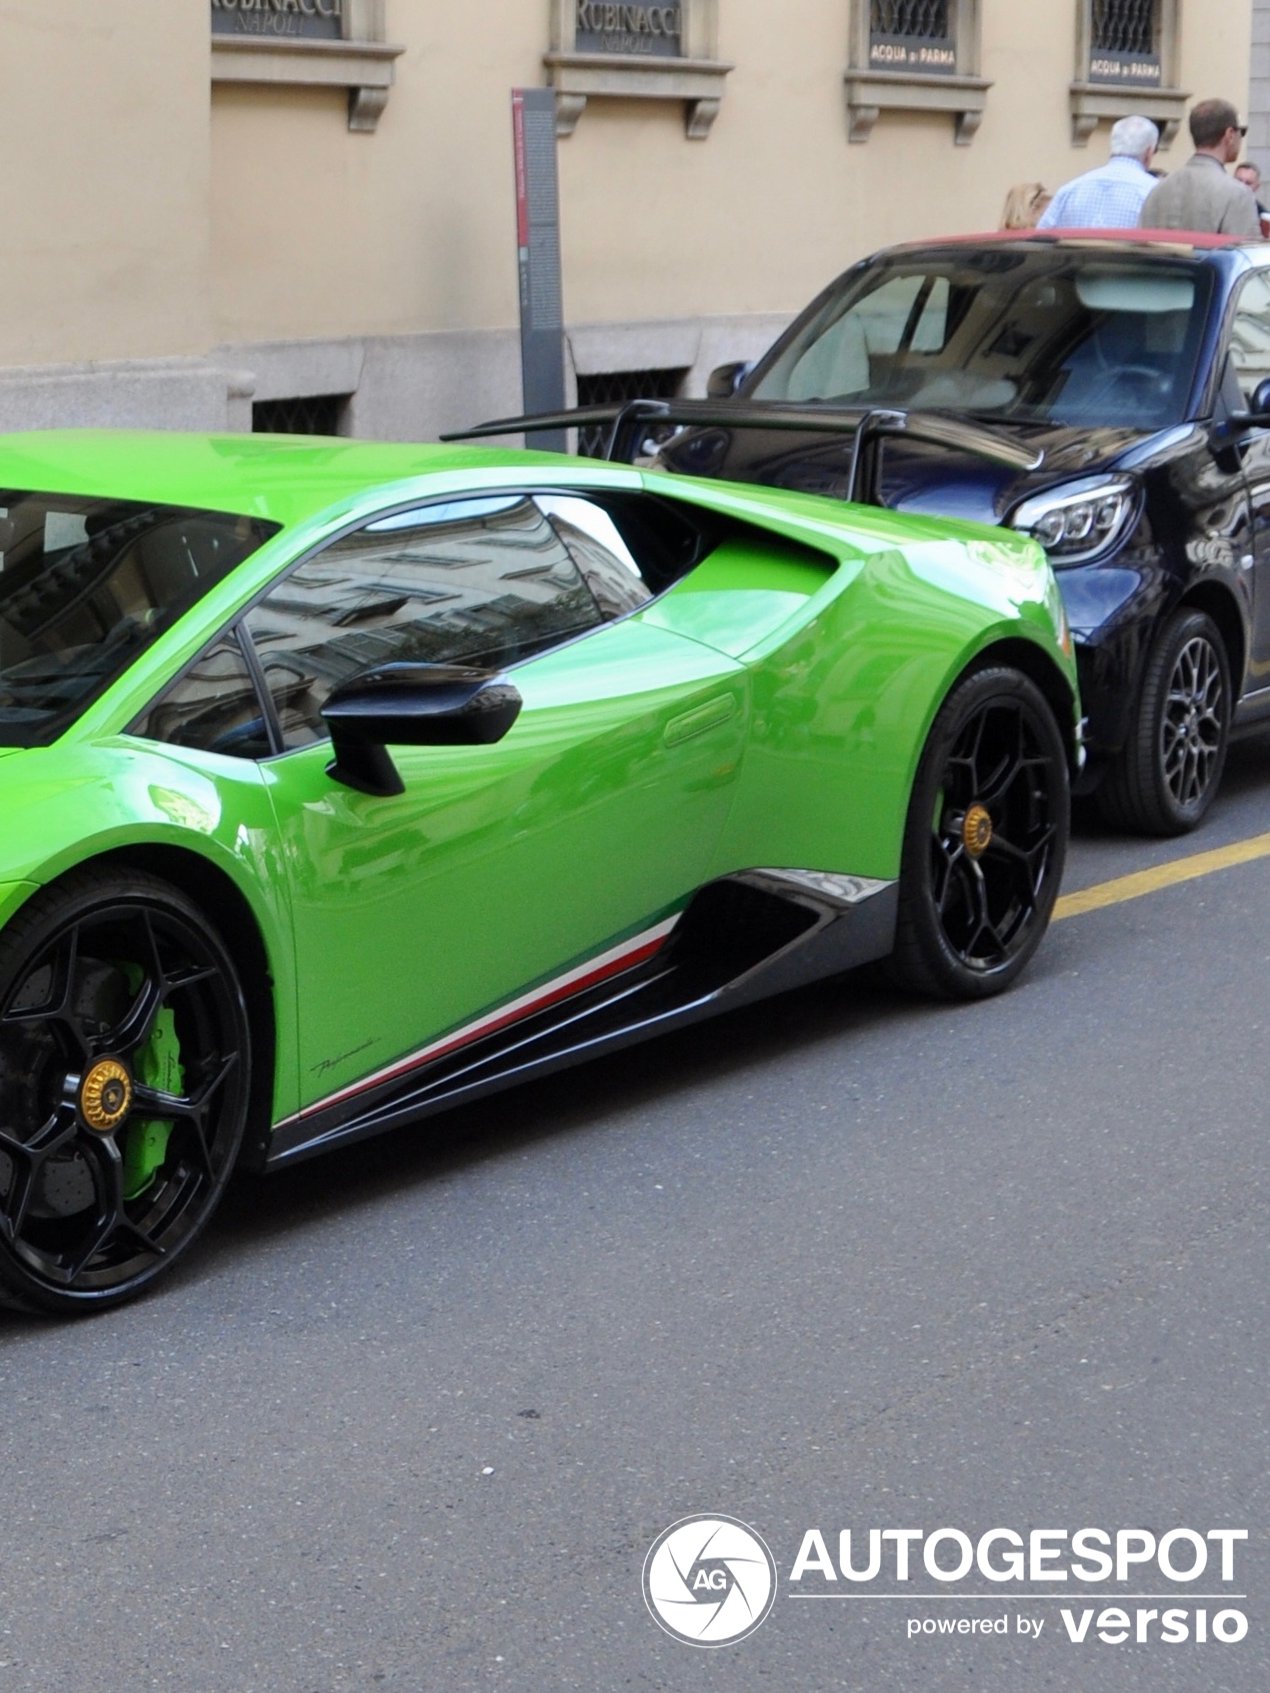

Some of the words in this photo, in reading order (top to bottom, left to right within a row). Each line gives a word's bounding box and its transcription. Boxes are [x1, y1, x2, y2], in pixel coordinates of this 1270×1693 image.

[235, 12, 304, 34] NAPOLI
[871, 44, 907, 62] ACQUA
[920, 47, 956, 65] PARMA
[1091, 59, 1120, 75] ACQUA
[1131, 62, 1160, 79] PARMA
